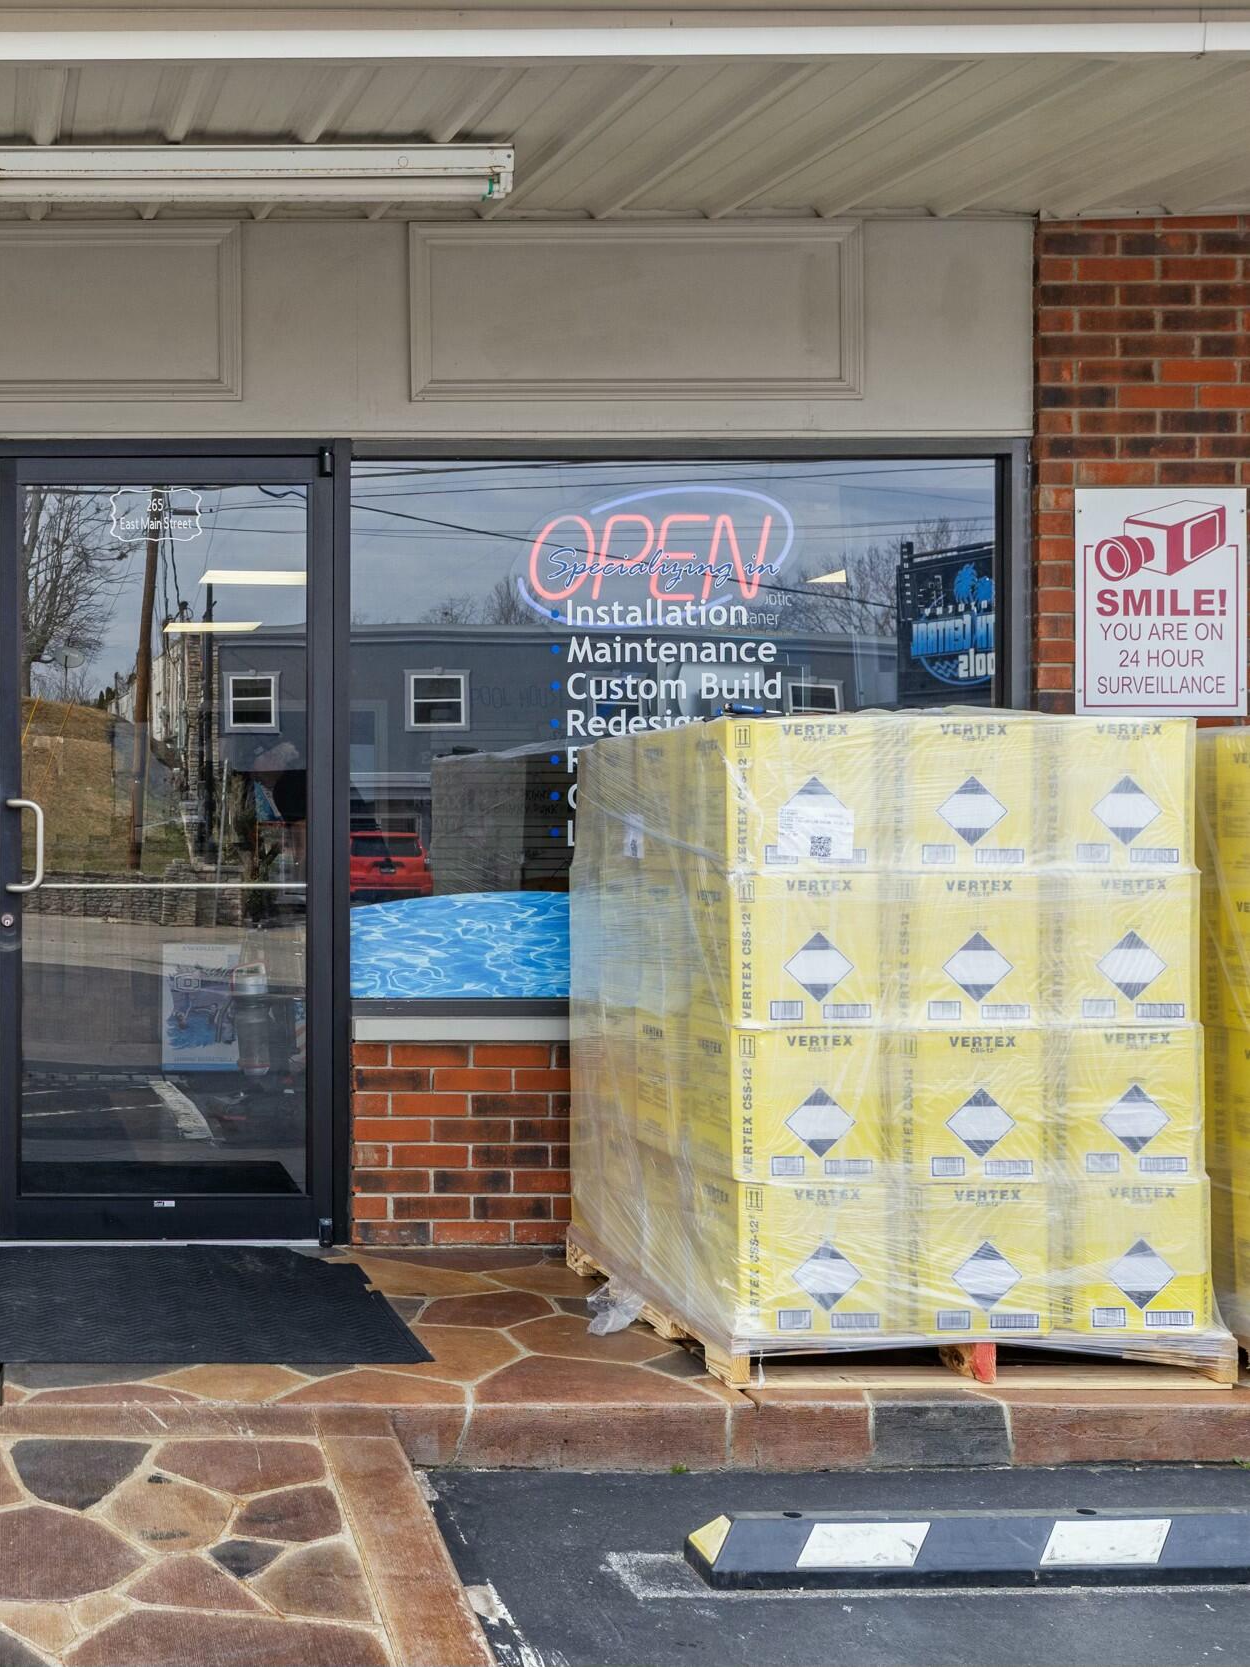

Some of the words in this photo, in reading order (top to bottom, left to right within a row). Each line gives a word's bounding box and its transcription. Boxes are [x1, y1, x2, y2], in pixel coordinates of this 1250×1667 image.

[147, 499, 163, 512] 265
[120, 517, 139, 530] East
[141, 517, 162, 530] Main
[164, 517, 192, 530] Street
[529, 514, 772, 600] OPEN
[547, 547, 733, 591] Specializing
[740, 554, 780, 577] in
[1096, 589, 1227, 617] SMILE!
[567, 599, 748, 626] Installation
[1100, 623, 1142, 641] YOU
[1148, 623, 1187, 641] ARE
[1195, 623, 1223, 641] ON
[567, 636, 777, 663] Maintenance
[1119, 649, 1141, 668] 24
[1147, 649, 1205, 668] HOUR
[567, 673, 687, 700] Custom
[701, 672, 782, 700] Build
[1097, 675, 1226, 694] SURVEILLANCE
[567, 709, 704, 737] Redesi
[1097, 724, 1162, 735] VERTEX
[782, 724, 848, 736] VERTEX
[940, 724, 1007, 736] VERTEX
[735, 807, 748, 864] VERTEX
[786, 880, 852, 891] VERTEX
[946, 880, 1012, 891] VERTEX
[1101, 879, 1166, 890] VERTEX
[741, 962, 752, 1019] VERTEX
[787, 1035, 853, 1046] VERTEX
[950, 1036, 1016, 1047] VERTEX
[1105, 1033, 1171, 1044] VERTEX
[742, 1117, 753, 1173] VERTEX
[794, 1189, 861, 1200] VERTEX
[954, 1190, 1021, 1201] VERTEX
[1110, 1187, 1176, 1198] VERTEX
